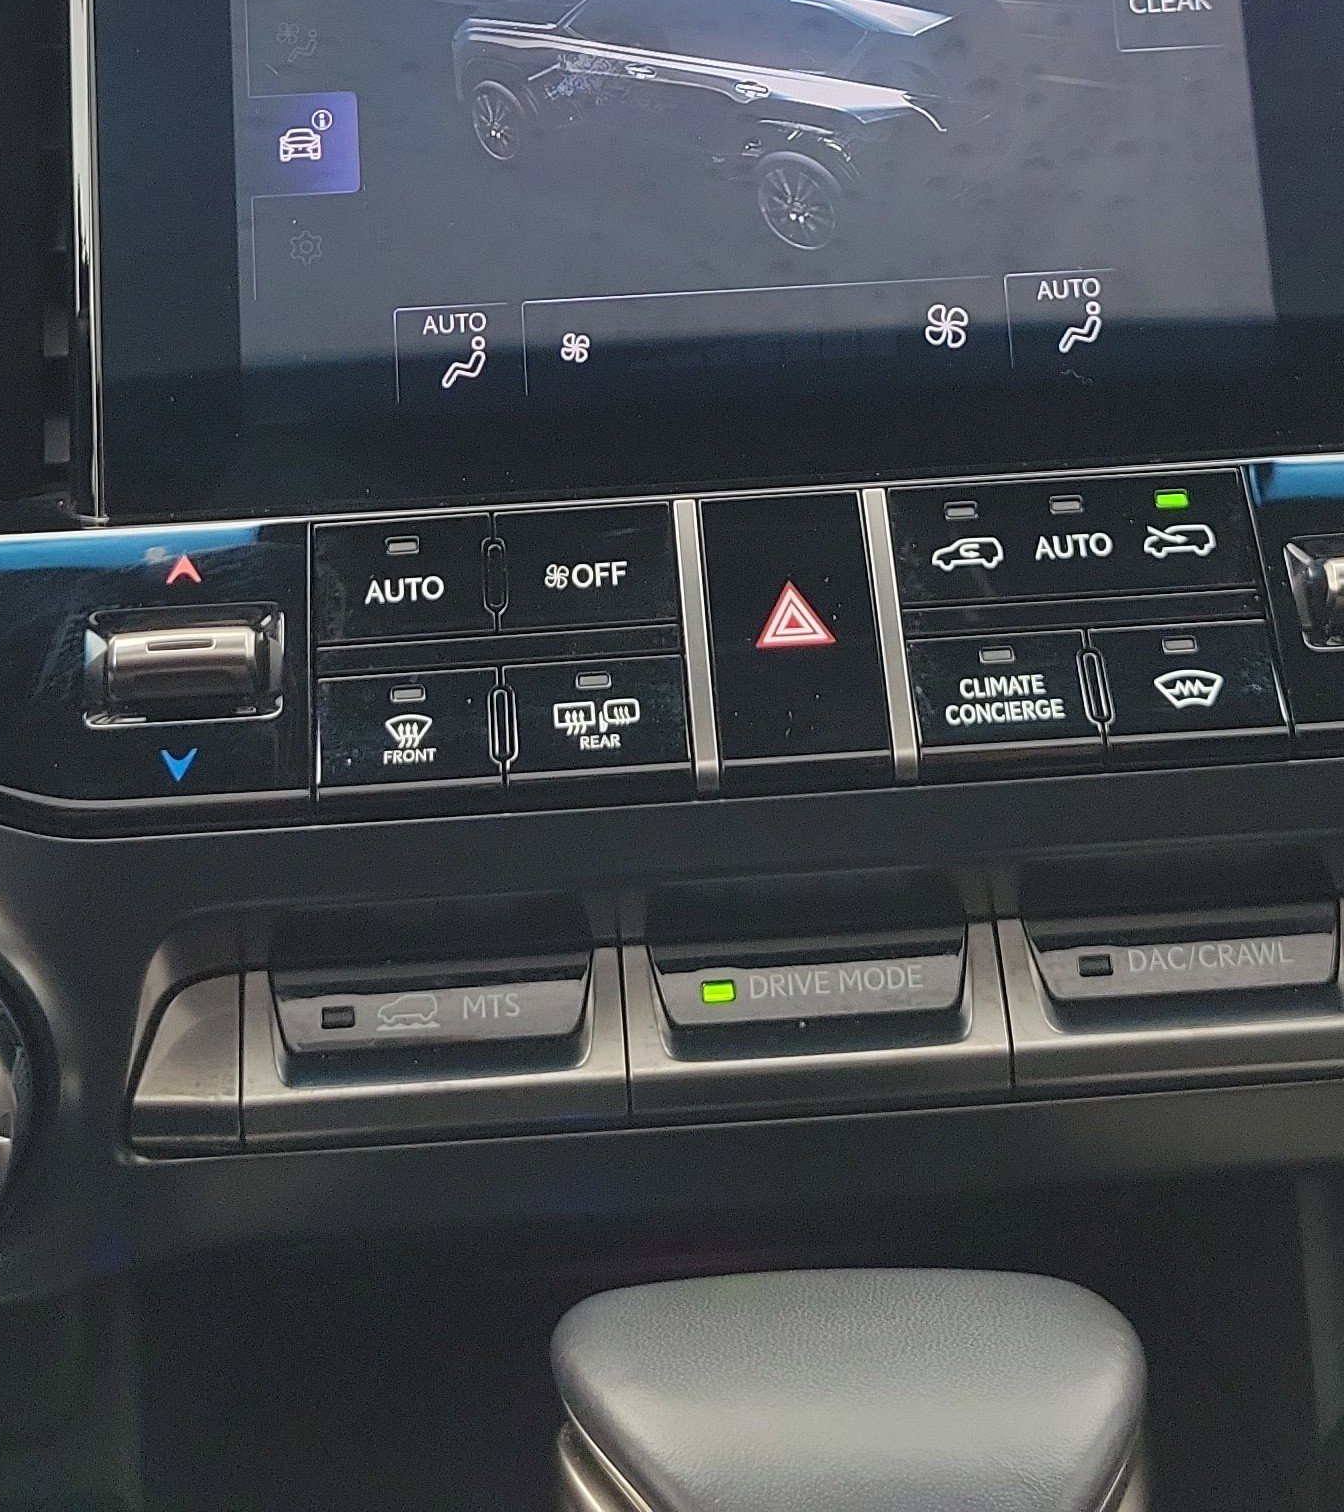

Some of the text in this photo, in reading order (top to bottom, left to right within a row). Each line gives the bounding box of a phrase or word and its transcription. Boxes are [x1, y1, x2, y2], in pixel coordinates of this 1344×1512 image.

[1037, 279, 1100, 300] AUTO
[423, 312, 486, 334] AUTO
[1035, 532, 1113, 561] AUTO
[571, 561, 627, 589] OFF
[365, 575, 444, 605] AUTO
[959, 673, 1047, 699] CLIMATE
[945, 697, 1066, 726] CONCIERGE
[580, 733, 621, 751] REAR
[383, 747, 437, 765] FRONT
[1128, 940, 1294, 973] DAC/CRAWL
[749, 965, 922, 1000] DRIVE MODE
[462, 993, 520, 1019] MTS
